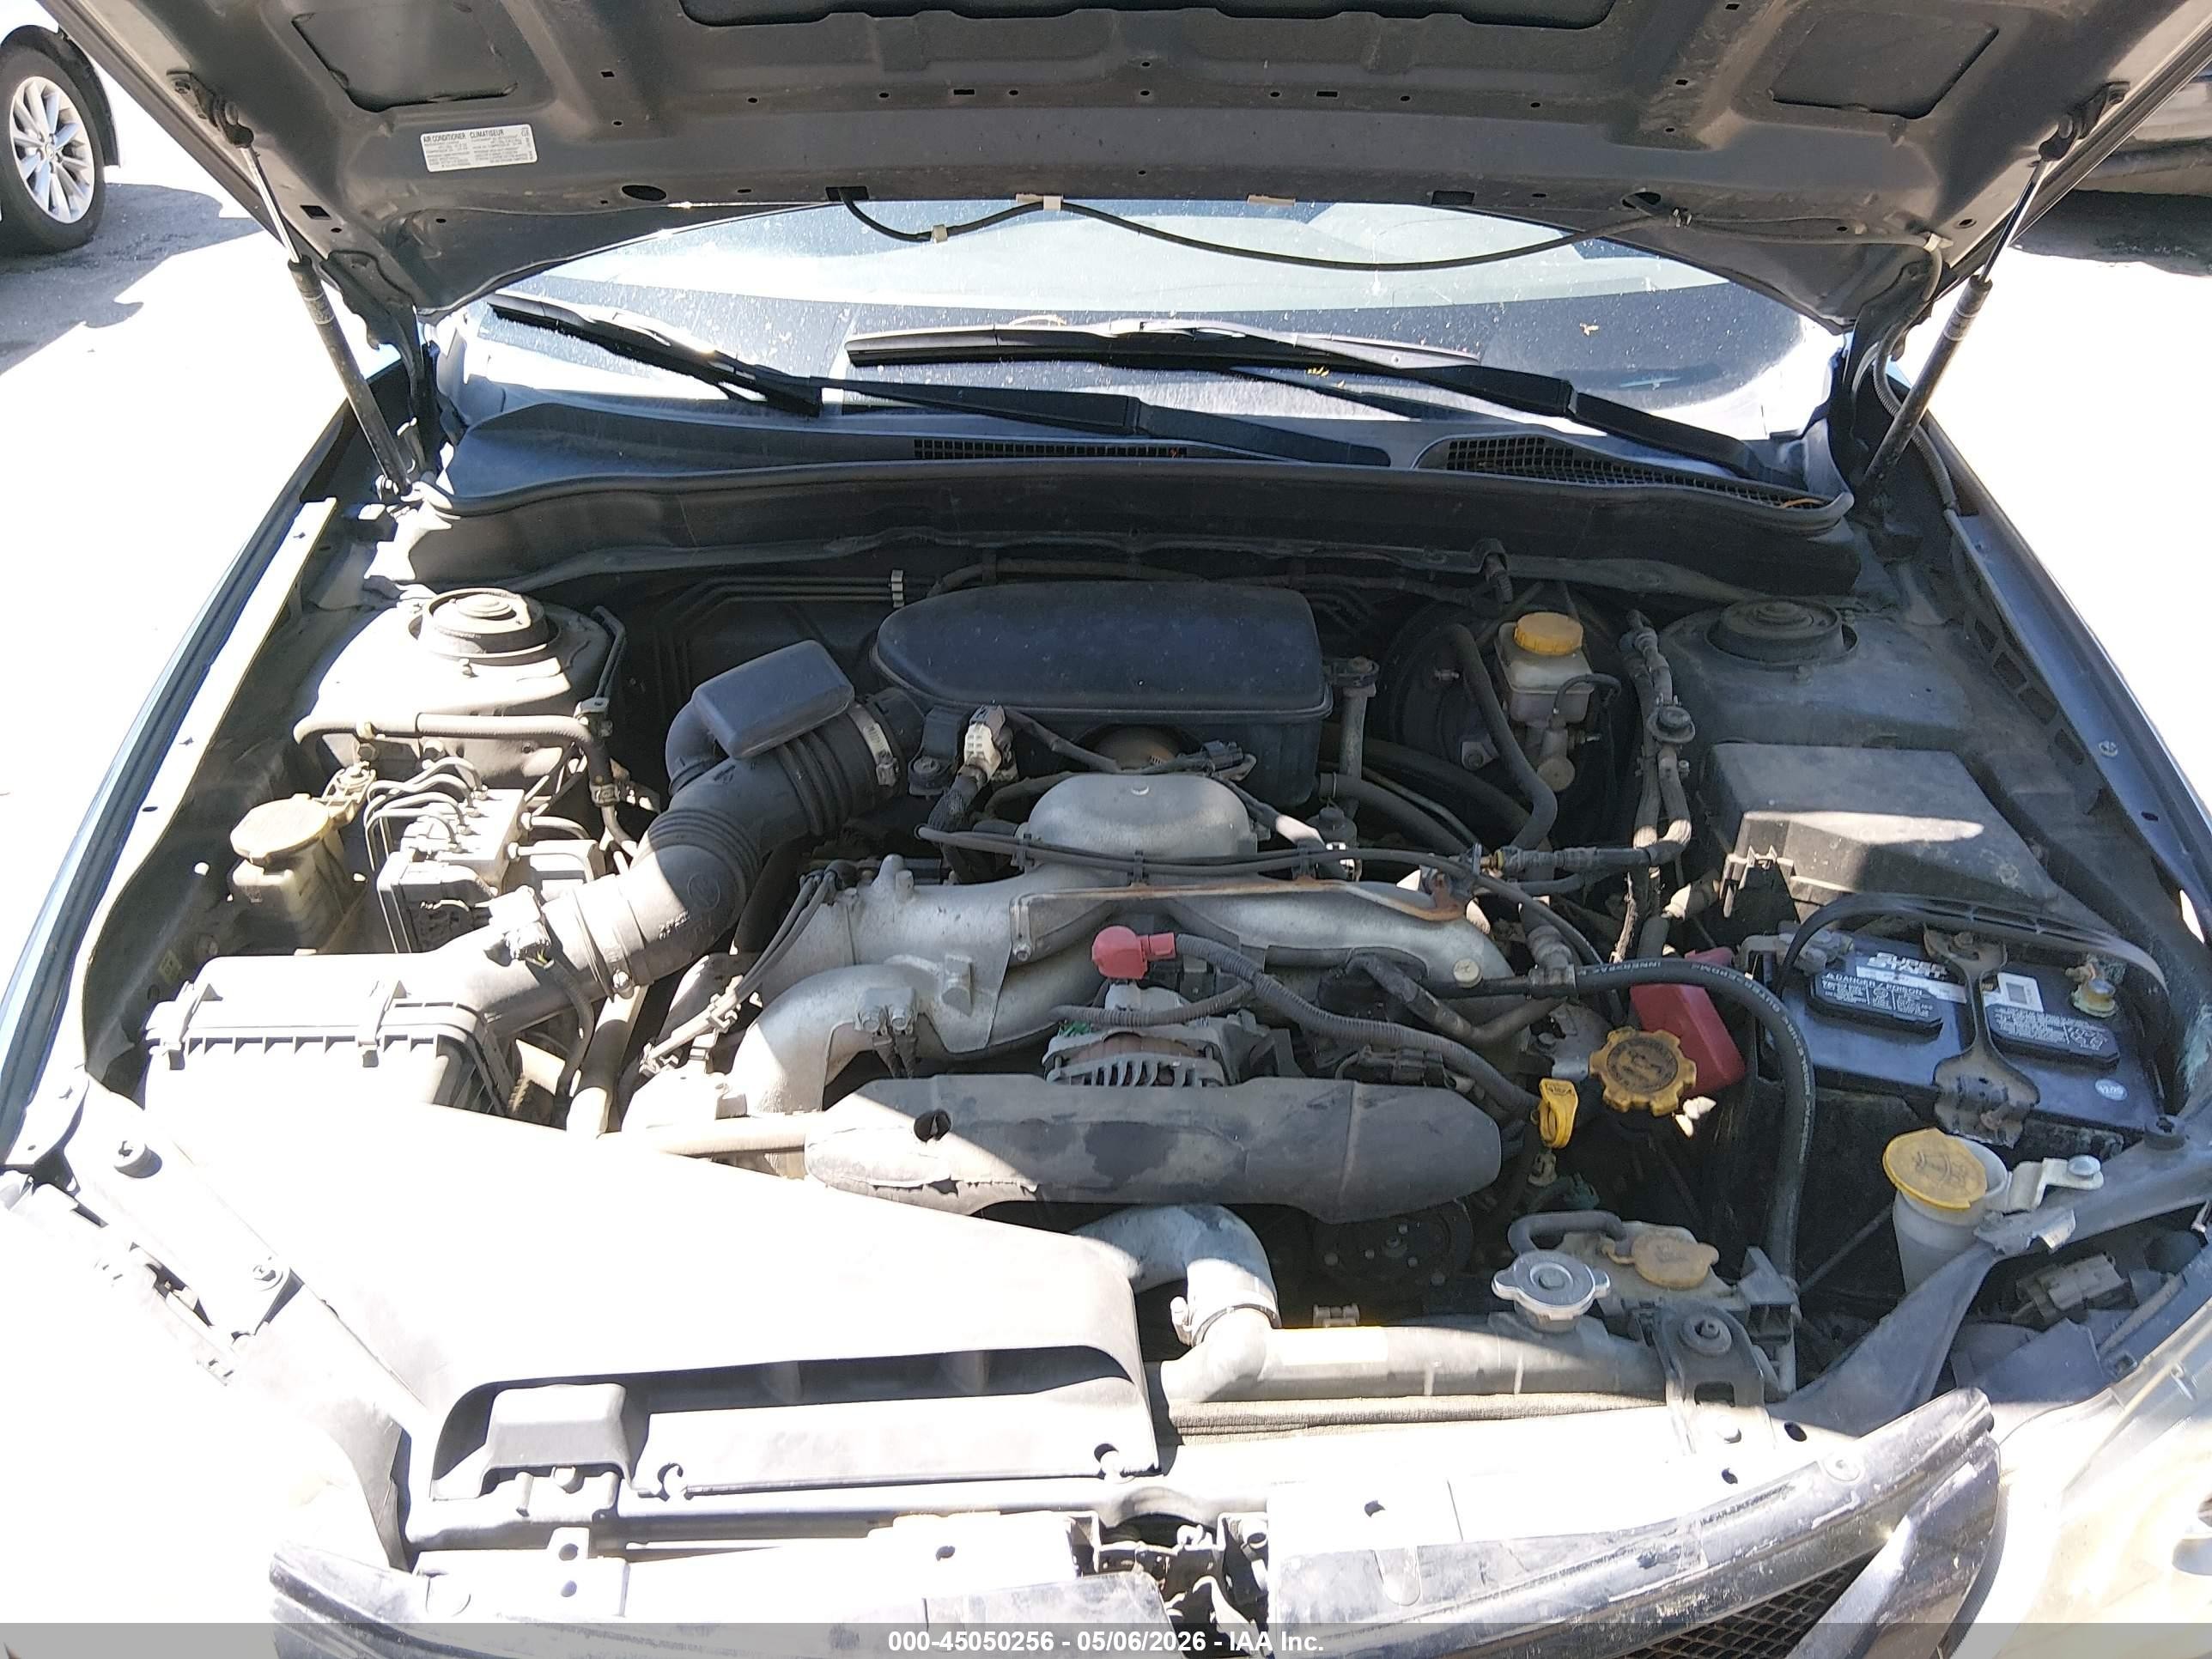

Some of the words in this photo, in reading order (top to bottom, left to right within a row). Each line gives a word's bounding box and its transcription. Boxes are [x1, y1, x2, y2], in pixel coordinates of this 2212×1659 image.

[432, 132, 465, 142] CONDITIONER
[469, 129, 504, 138] CLIMATISEUR
[1876, 951, 1948, 974] SUPER
[1835, 973, 1876, 988] DANGER
[1885, 984, 1923, 996] POISON
